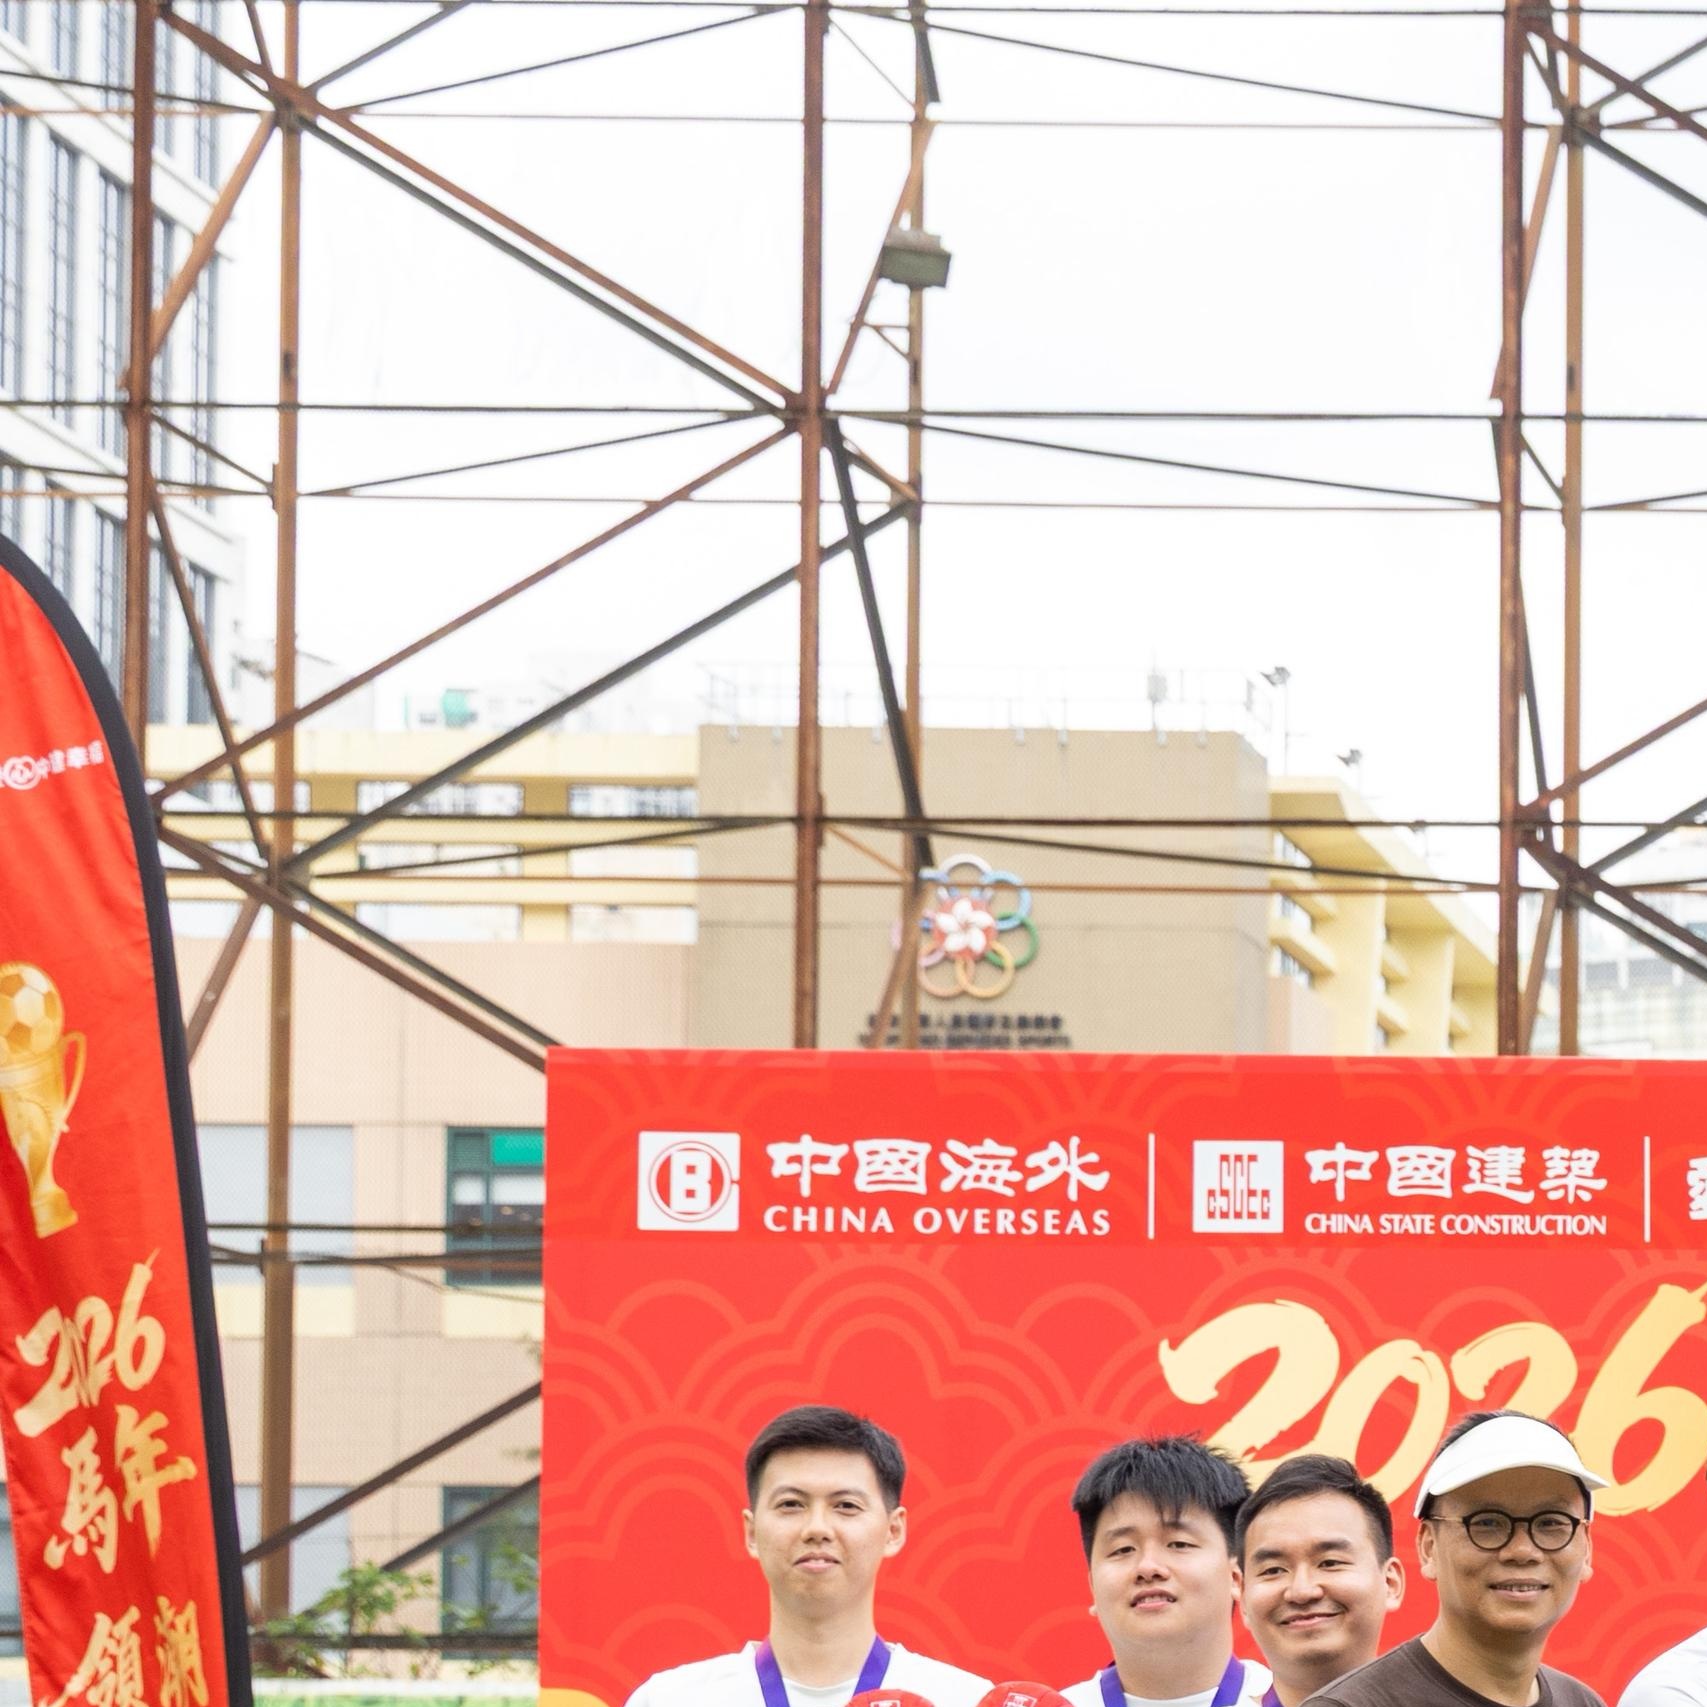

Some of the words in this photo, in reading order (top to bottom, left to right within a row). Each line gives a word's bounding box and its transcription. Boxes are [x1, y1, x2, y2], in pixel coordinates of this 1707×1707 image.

[766, 1134, 1110, 1202] 中國海外
[1304, 1141, 1608, 1204] 中國建築
[763, 1205, 894, 1233] CHINA
[913, 1207, 1110, 1236] OVERSEAS
[1304, 1213, 1374, 1234] CHINA
[1379, 1213, 1435, 1235] STATE
[1440, 1214, 1607, 1236] CONSTRUCTION
